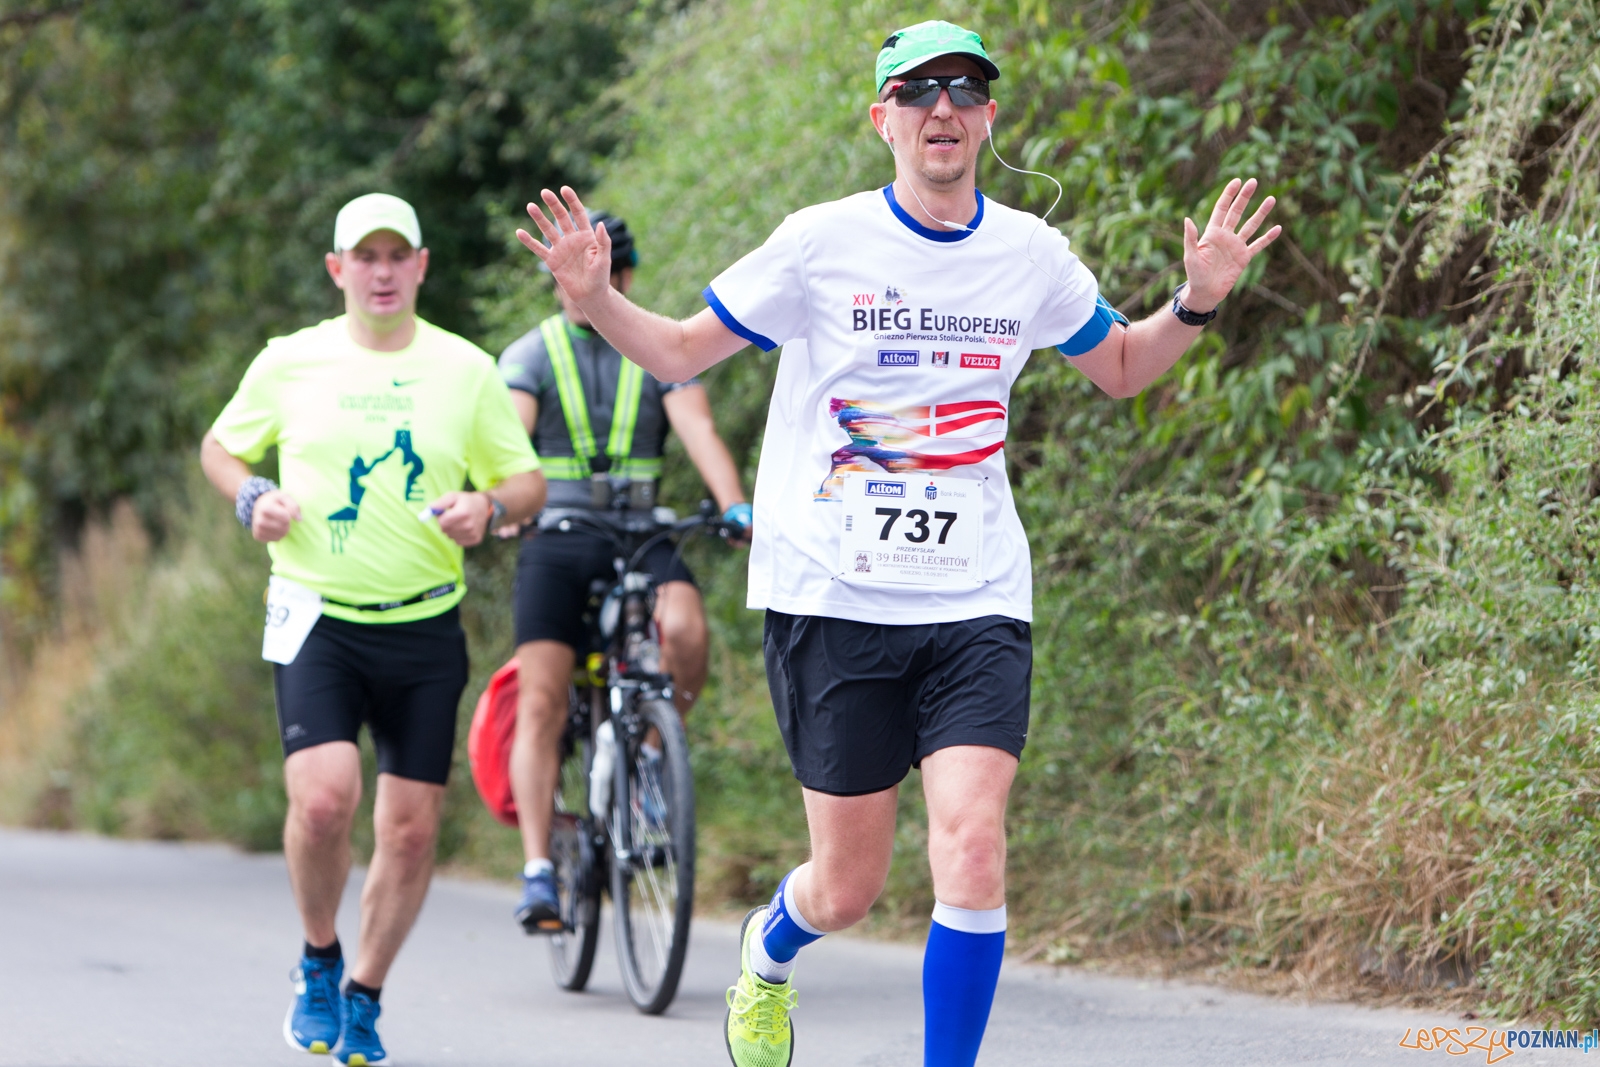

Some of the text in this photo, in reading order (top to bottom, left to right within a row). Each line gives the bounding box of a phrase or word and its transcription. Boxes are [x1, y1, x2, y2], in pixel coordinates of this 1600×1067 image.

[853, 294, 875, 306] XIV
[853, 308, 1021, 336] BIEG EUROPEJSKI
[874, 333, 905, 341] Gniezno
[906, 333, 938, 342] Pierwsza
[939, 334, 963, 343] Stolica
[964, 336, 987, 345] Polski,
[963, 356, 998, 367] VELUX
[875, 507, 958, 545] 737
[896, 546, 936, 554] PRZEMYSŁAW
[876, 552, 970, 567] 39 BIEG LECHITÓW
